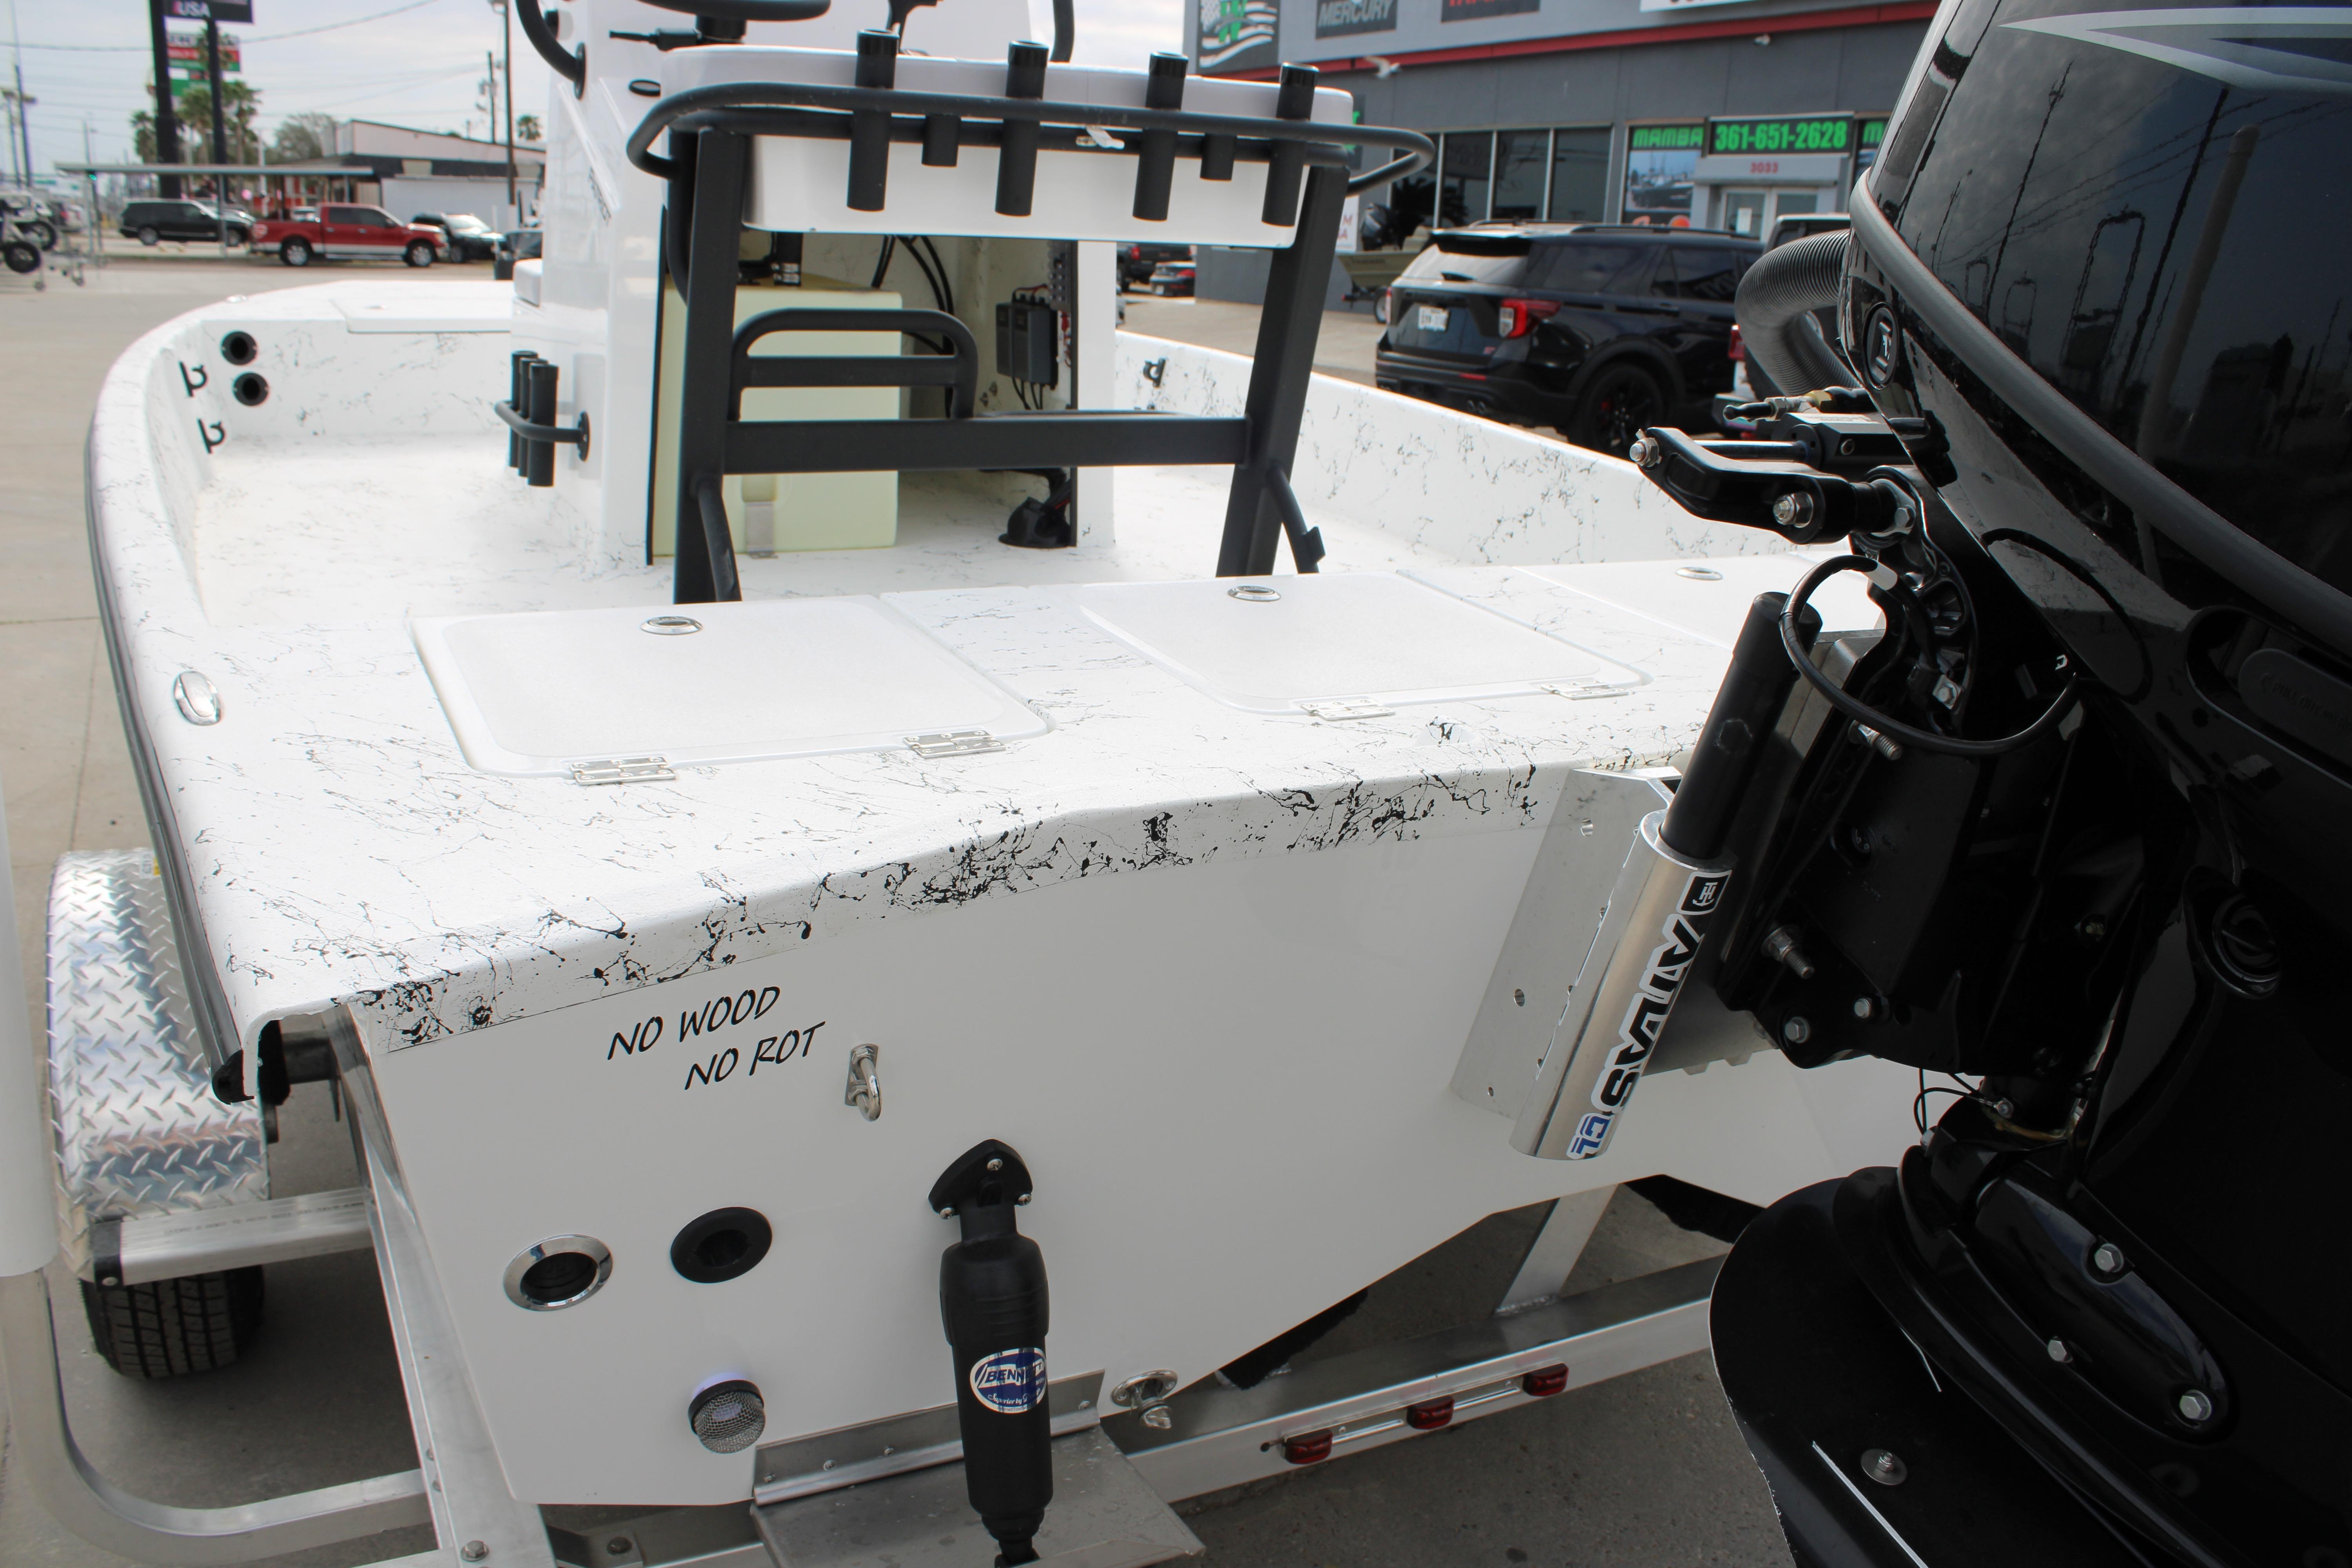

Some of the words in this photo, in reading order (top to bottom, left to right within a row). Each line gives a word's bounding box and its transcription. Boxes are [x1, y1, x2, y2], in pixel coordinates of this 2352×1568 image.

[1317, 0, 1393, 27] MERCURY
[1633, 127, 1704, 147] MAMBA
[1715, 121, 1847, 151] 361-651-2628
[1750, 162, 1778, 173] 3033
[608, 1016, 663, 1060] NO
[679, 986, 780, 1042] WOOD
[685, 1048, 739, 1090] NO
[749, 1021, 825, 1076] ROT
[1570, 1116, 1610, 1155] CL
